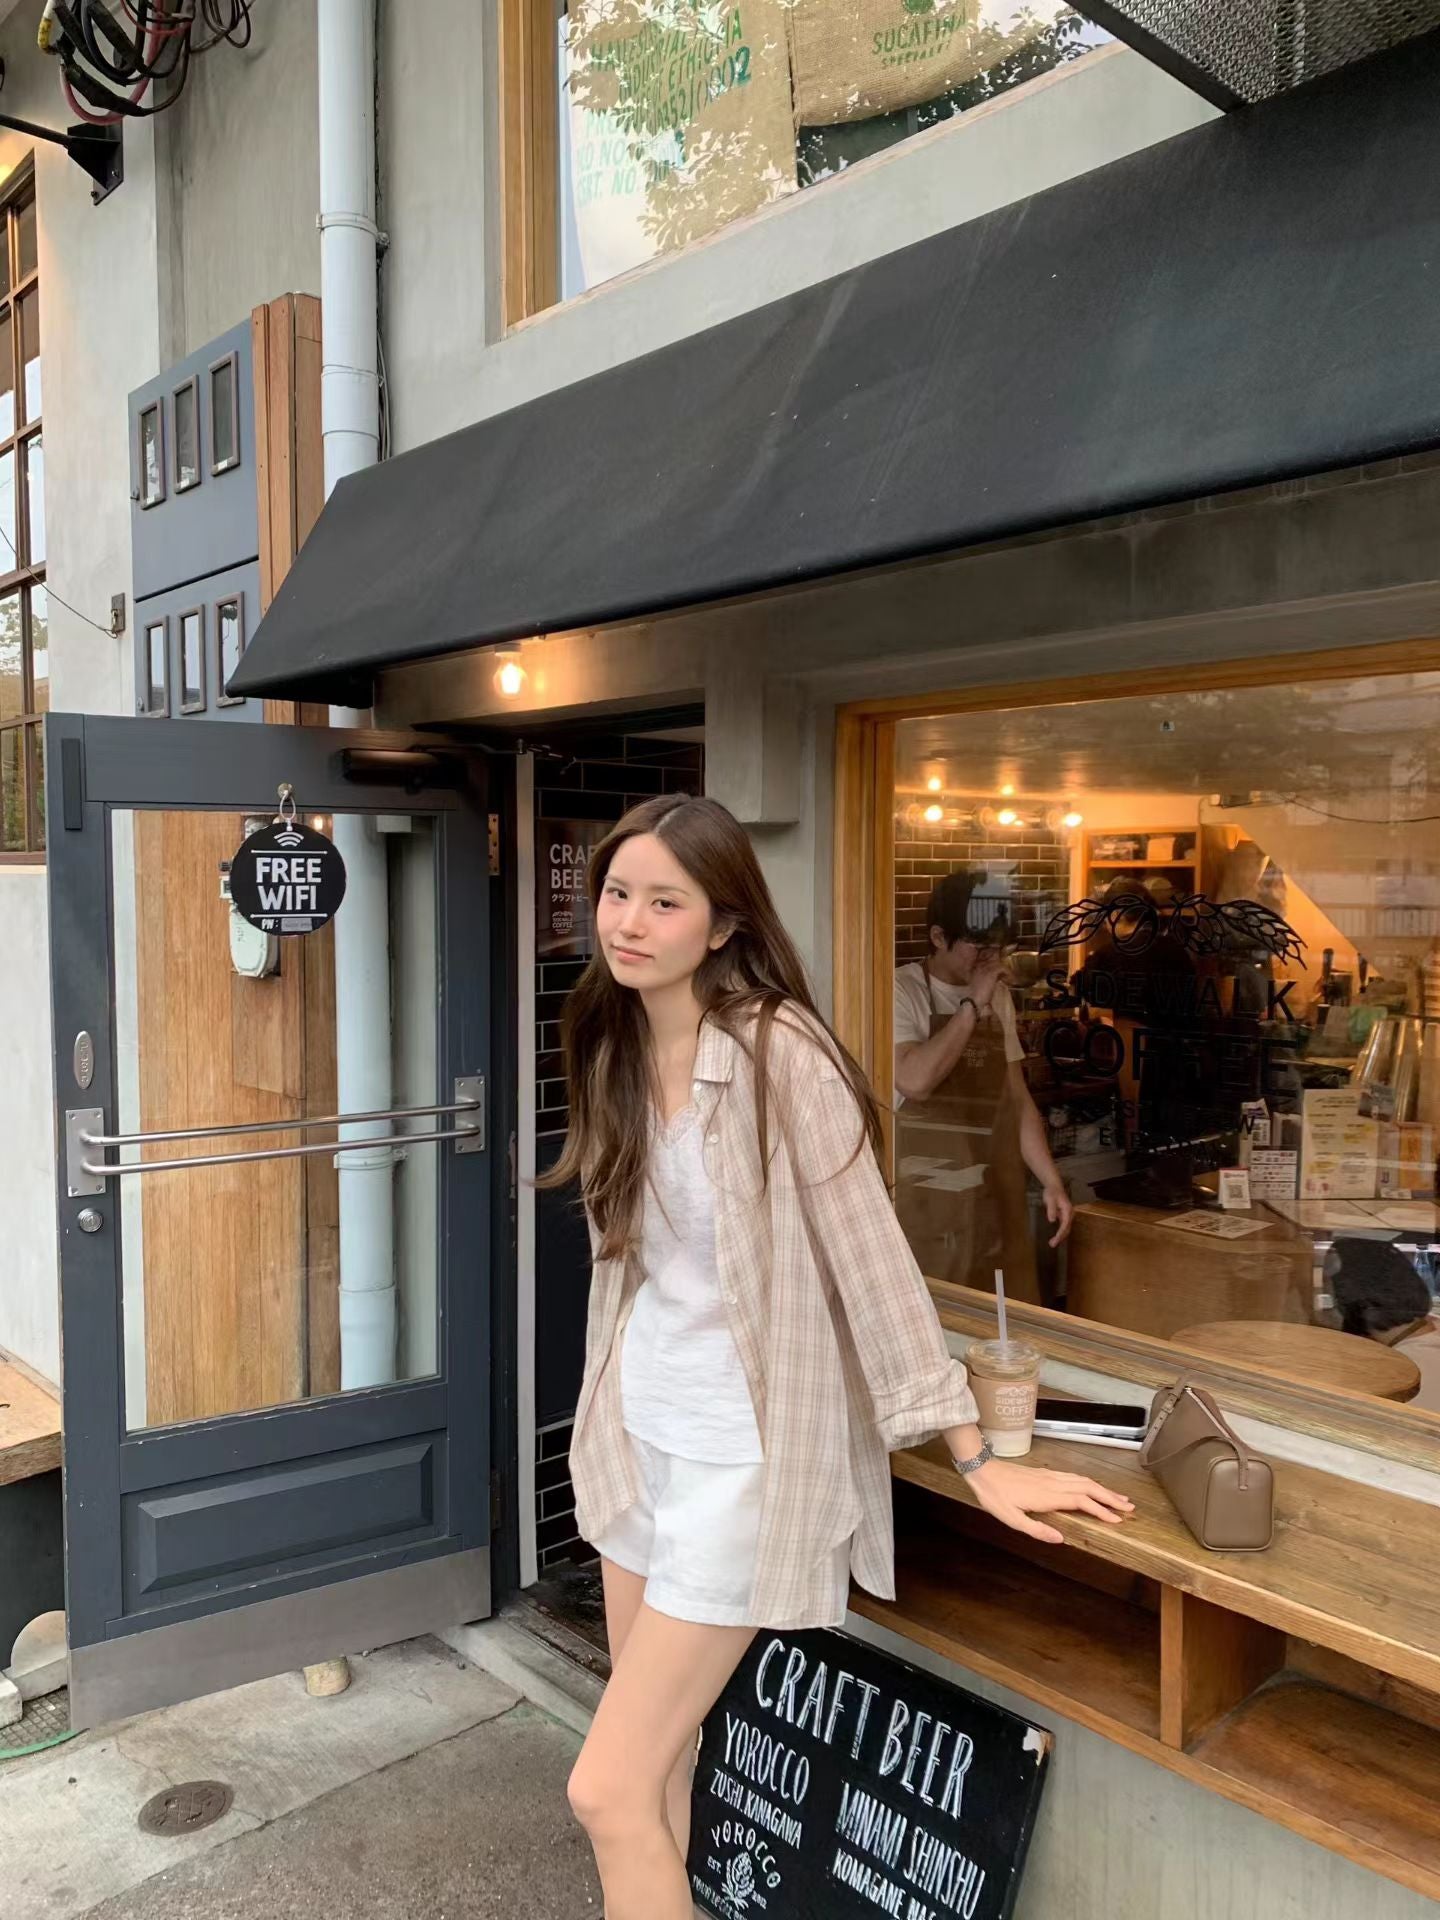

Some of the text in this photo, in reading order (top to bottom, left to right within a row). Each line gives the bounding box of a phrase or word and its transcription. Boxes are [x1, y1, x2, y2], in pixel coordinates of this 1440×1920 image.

[256, 857, 322, 883] FREE
[549, 843, 597, 864] CRAF
[551, 868, 583, 889] BEE
[257, 885, 317, 911] WIFI
[551, 893, 590, 903] クラフトビー
[1043, 1020, 1298, 1099] COFE
[725, 1711, 810, 1806] YOROCCO
[756, 1638, 974, 1820] CRAFT BEER
[710, 1819, 782, 1889] YOROCCO
[832, 1848, 907, 1920] KOMAGANE
[835, 1782, 986, 1920] MINAMI SHINSHU
